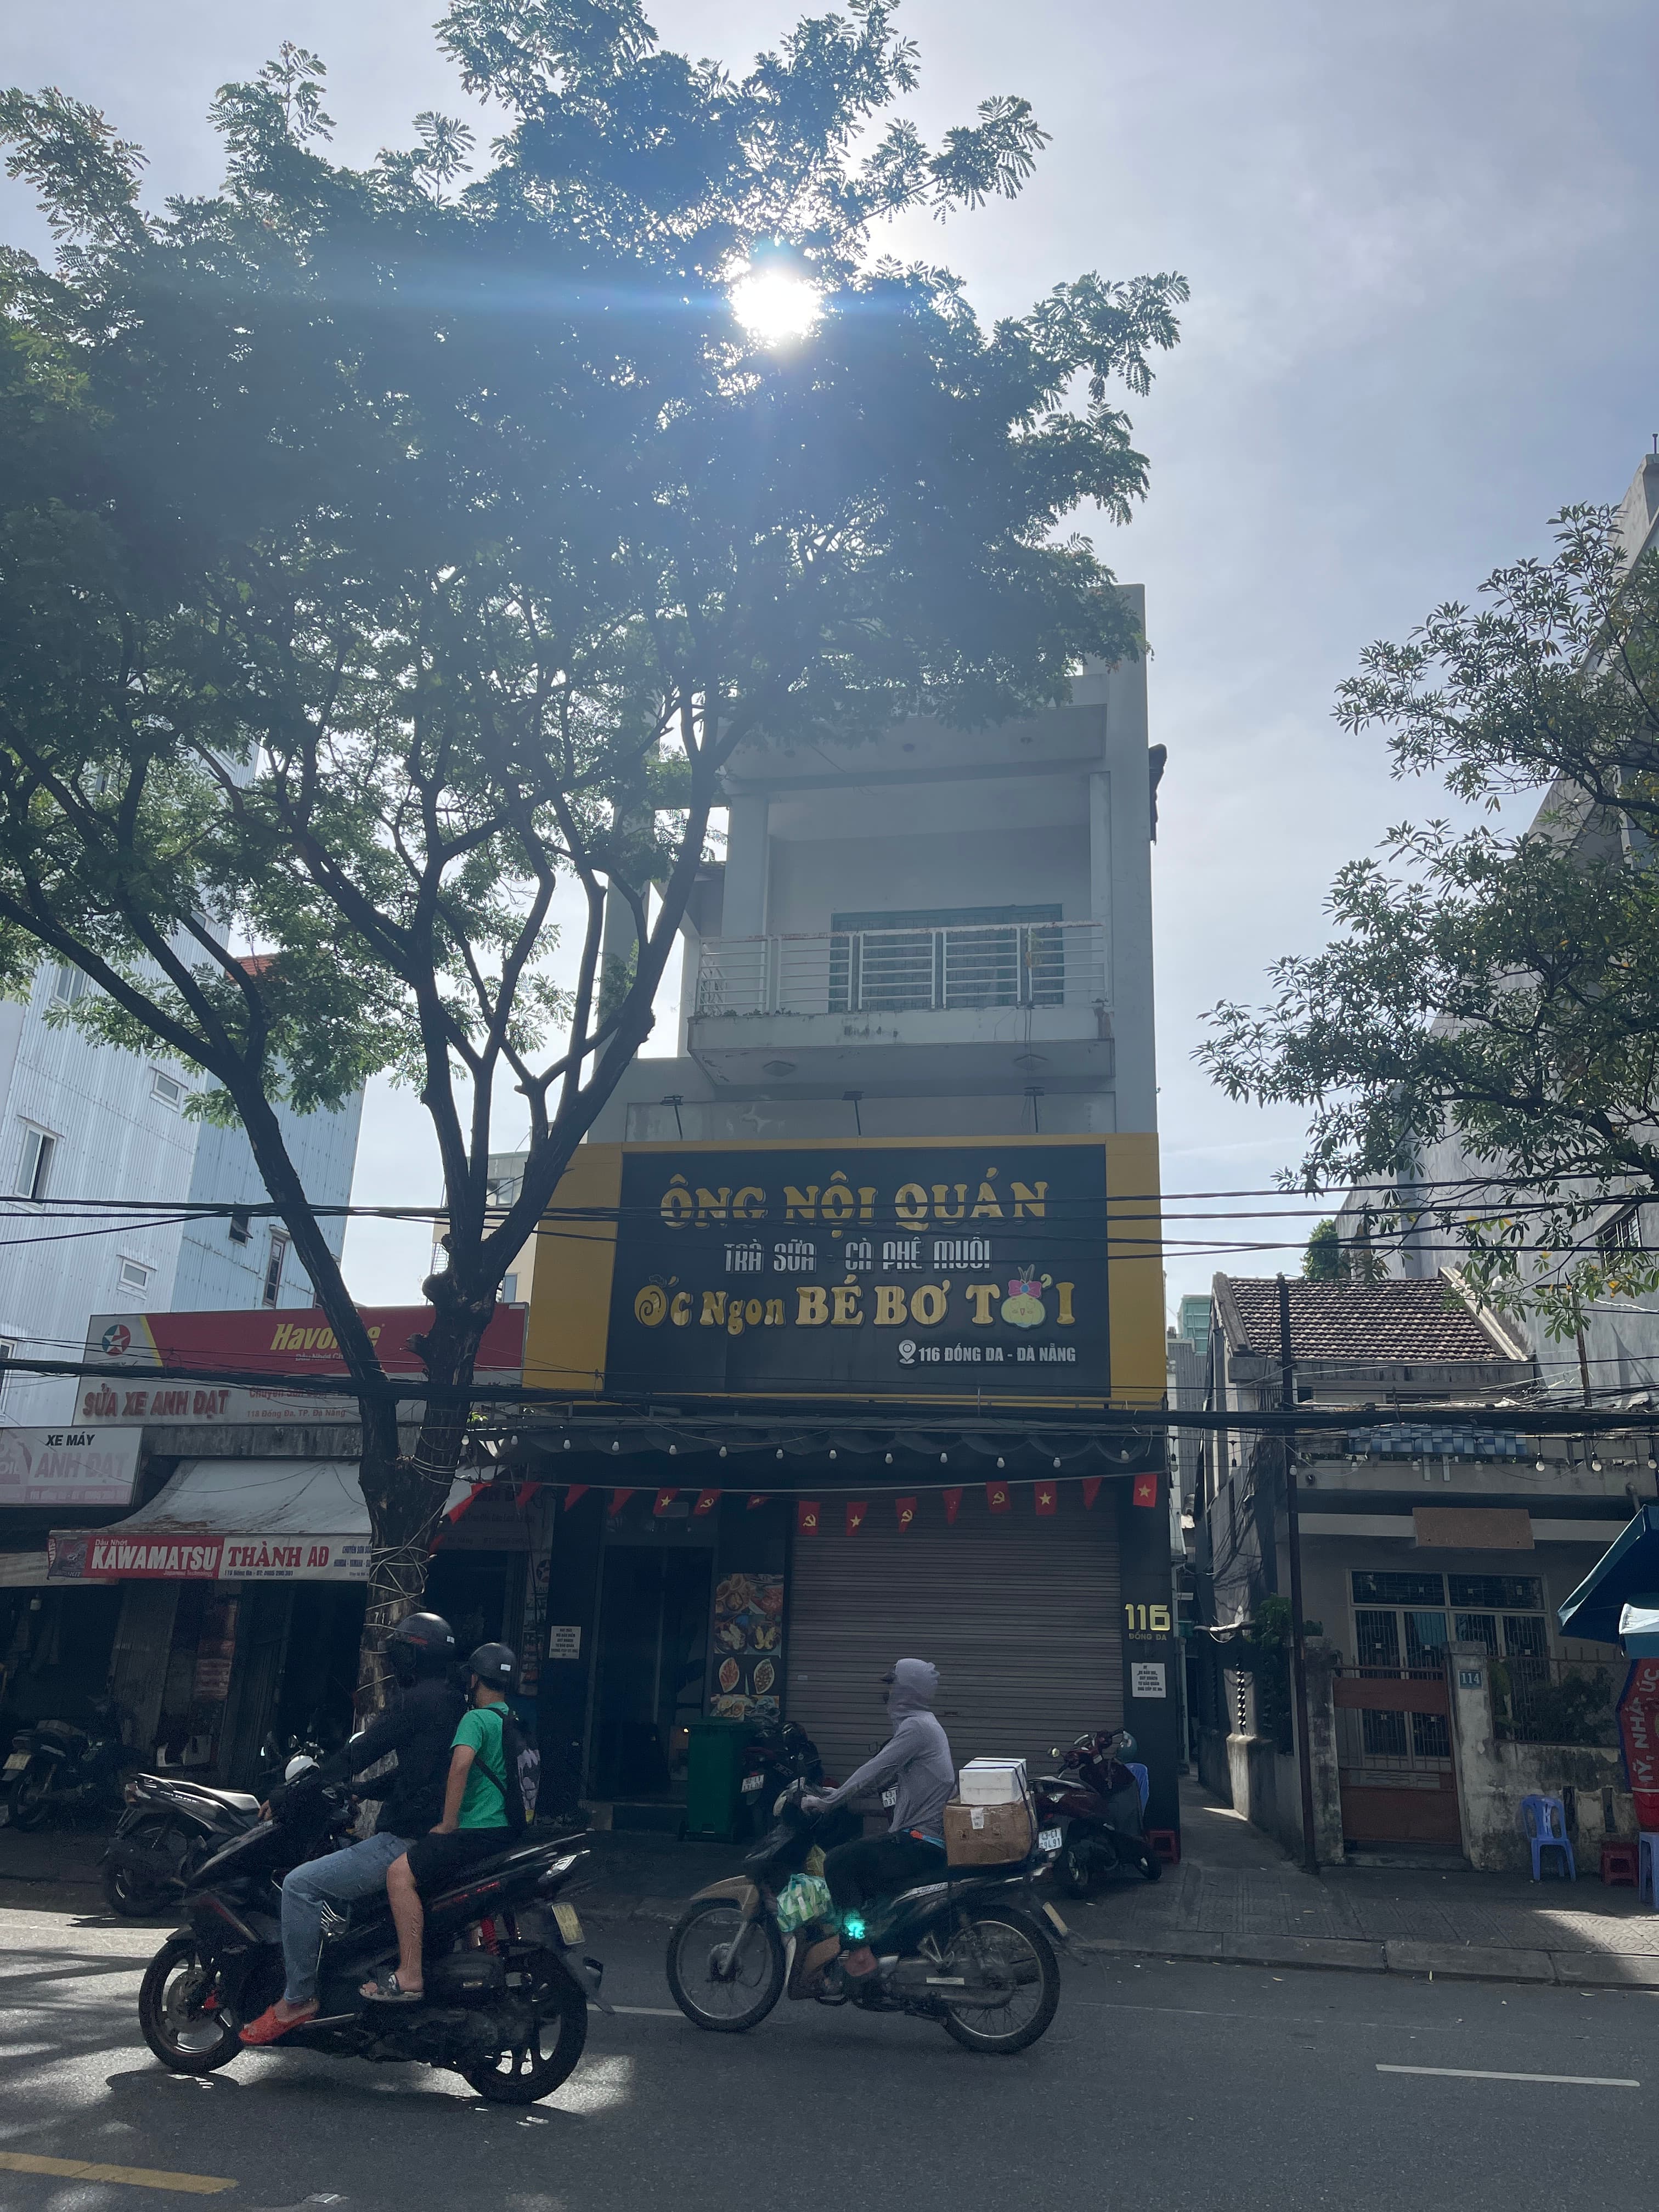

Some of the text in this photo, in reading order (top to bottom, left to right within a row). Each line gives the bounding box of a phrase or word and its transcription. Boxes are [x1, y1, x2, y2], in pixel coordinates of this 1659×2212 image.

[661, 1167, 1048, 1239] ÔNG NỘI QUÁN
[724, 1238, 763, 1272] TRÀ
[773, 1238, 815, 1272] SỮA
[845, 1237, 872, 1270] CÀ
[882, 1237, 922, 1270] PHÊ
[699, 1291, 786, 1336] Ngon
[795, 1273, 862, 1325] BÉ
[873, 1279, 950, 1325] BƠ
[270, 1323, 381, 1351] Havoe
[918, 1347, 940, 1362] 116
[944, 1342, 981, 1362] ĐỐNG
[83, 1382, 230, 1419] SỬA XE ANH ĐẠT
[46, 1431, 96, 1446] XE MÁY
[35, 1452, 82, 1479] ANH
[91, 1545, 218, 1571] KAWAMATSU
[228, 1541, 303, 1567] THÀNH
[1125, 1603, 1171, 1632] 116
[1460, 1672, 1480, 1684] 114
